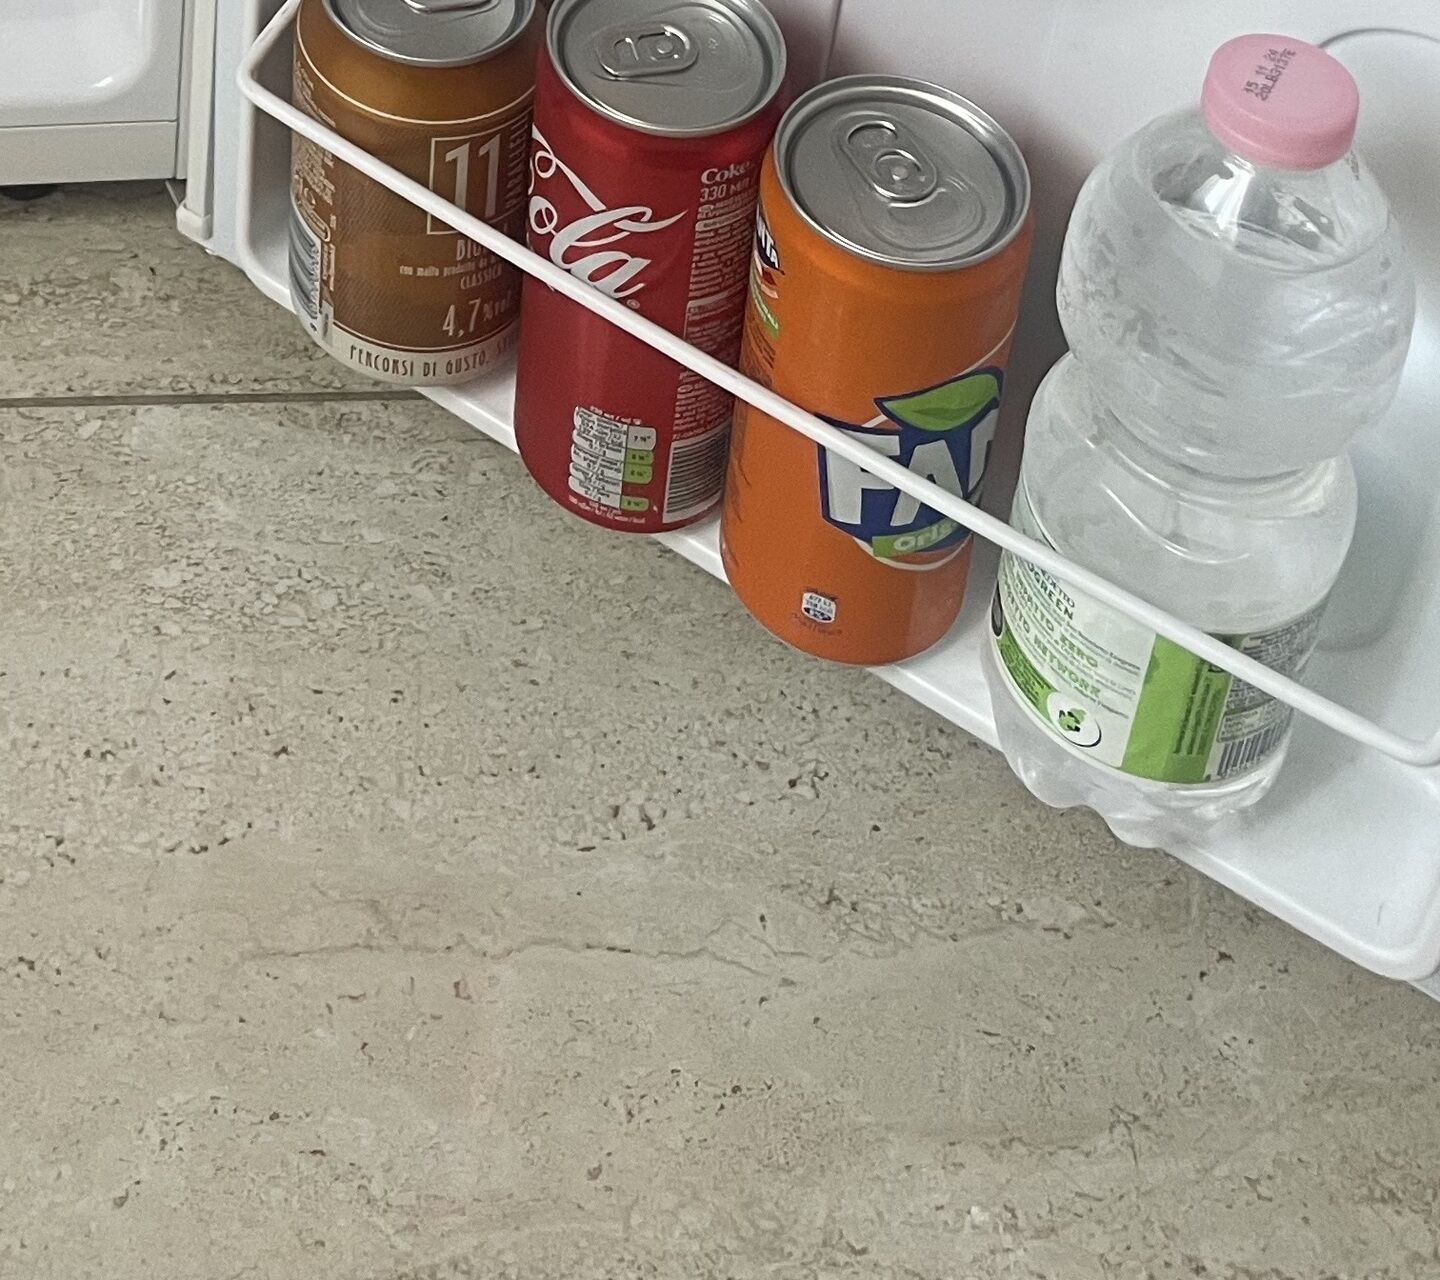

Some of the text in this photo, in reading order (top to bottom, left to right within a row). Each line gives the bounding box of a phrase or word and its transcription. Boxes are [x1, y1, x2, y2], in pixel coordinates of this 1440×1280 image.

[445, 132, 502, 219] 11
[700, 183, 728, 203] 330
[441, 296, 482, 339] 4,7
[349, 344, 415, 378] PERCORSI
[422, 361, 437, 377] DI
